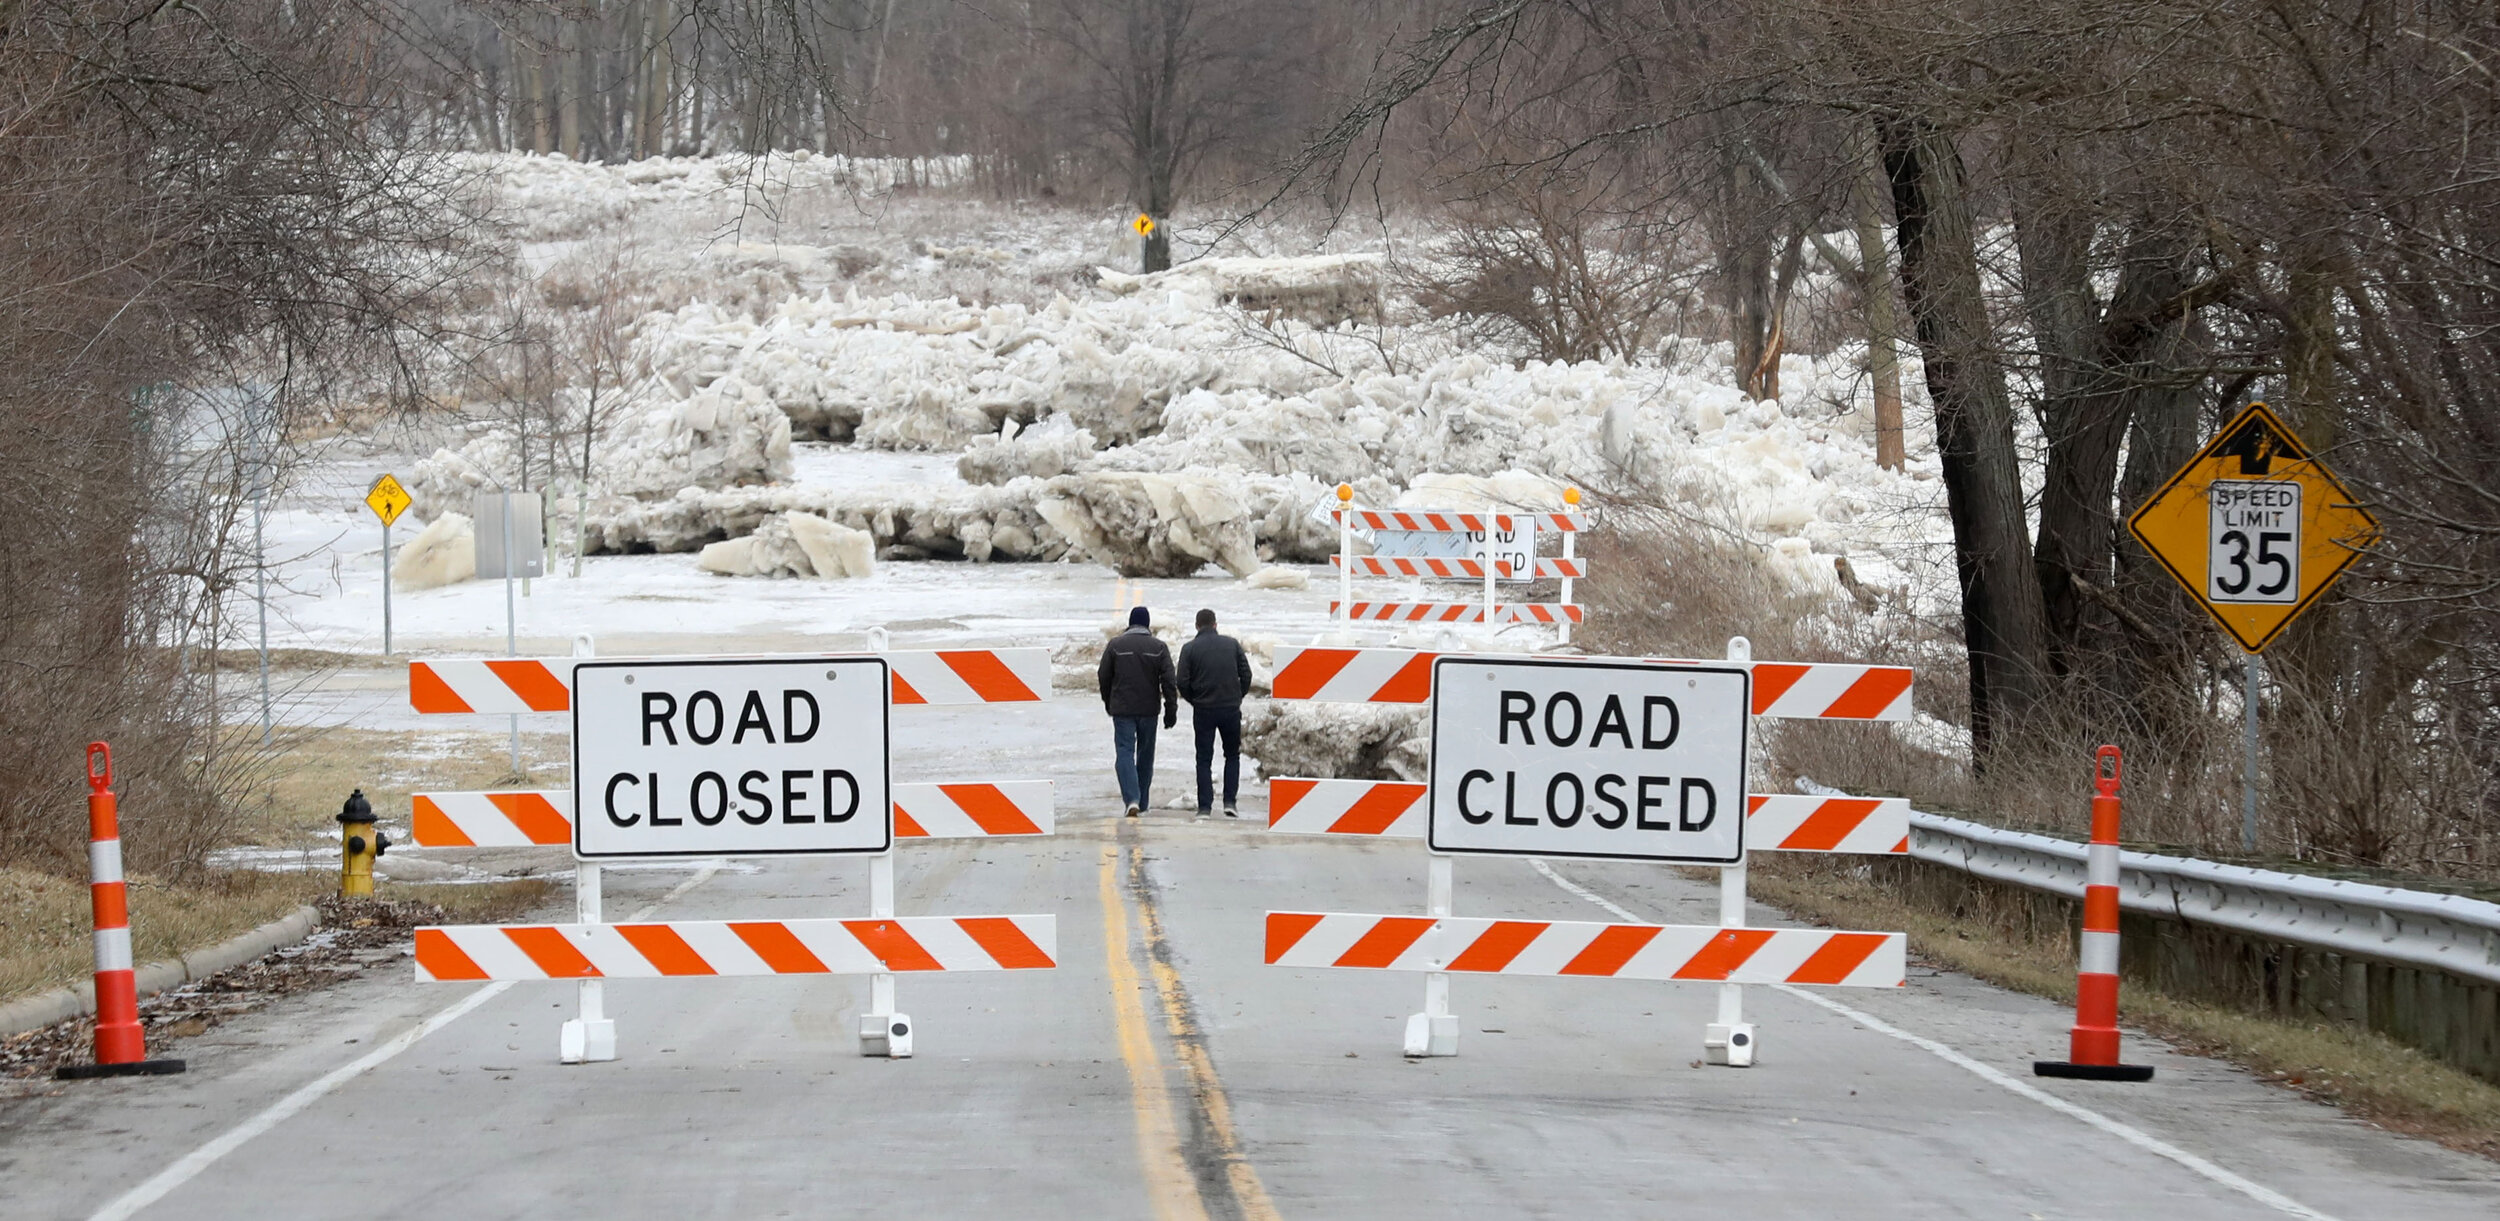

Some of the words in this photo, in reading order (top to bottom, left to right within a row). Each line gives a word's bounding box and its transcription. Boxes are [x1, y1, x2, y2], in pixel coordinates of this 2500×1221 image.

[1319, 495, 1338, 520] SPEED
[2216, 490, 2293, 507] SPEED
[2225, 511, 2284, 528] LIMIT
[2216, 530, 2292, 596] 35
[641, 689, 820, 746] ROAD
[1499, 690, 1680, 750] ROAD
[604, 769, 860, 827] CLOSED
[1457, 769, 1717, 832] CLOSED
